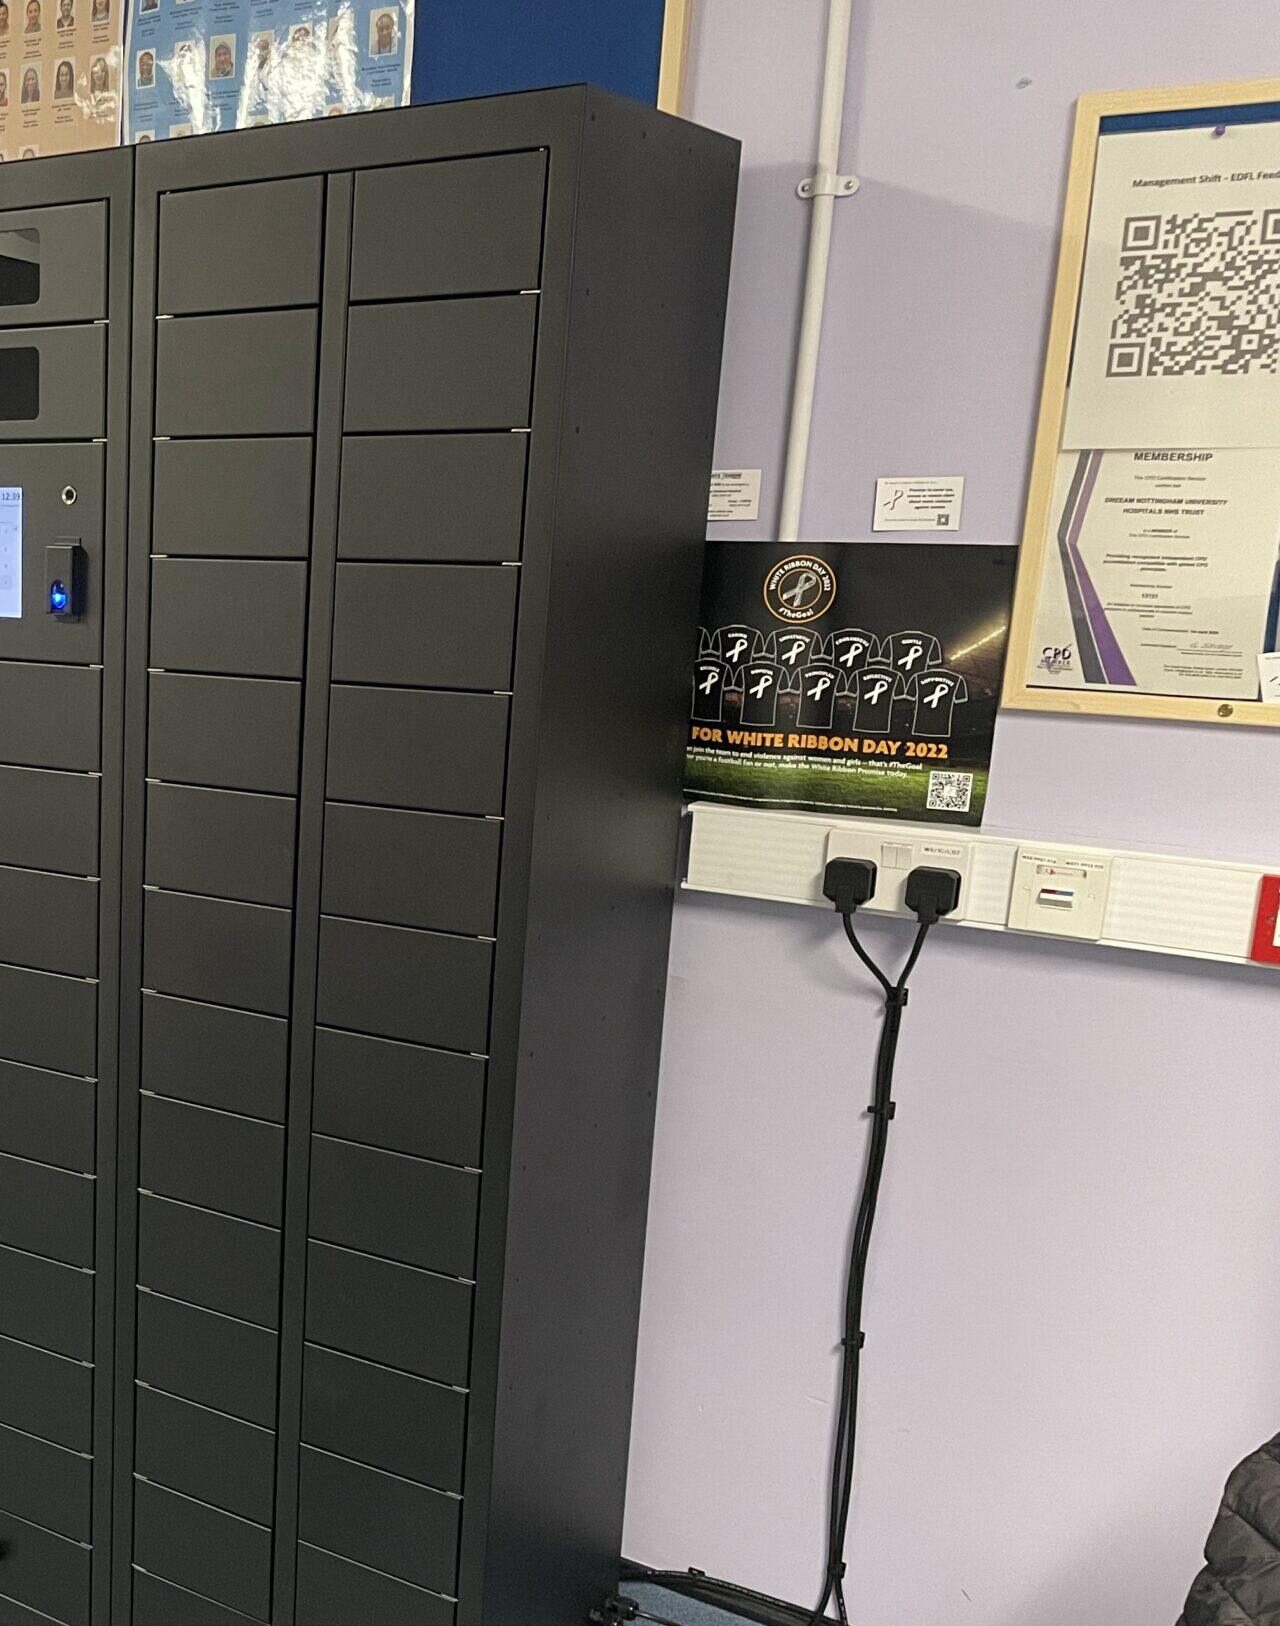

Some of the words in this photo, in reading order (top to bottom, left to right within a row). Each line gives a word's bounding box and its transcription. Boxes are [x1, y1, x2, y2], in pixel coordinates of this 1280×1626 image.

[1132, 175, 1196, 188] Management
[1198, 174, 1221, 184] Shift
[1230, 172, 1254, 182] EDFL
[1134, 452, 1213, 461] MEMBERSHIP
[769, 568, 785, 590] WHITE
[784, 561, 812, 571] RIBBON
[812, 564, 826, 576] DAY
[1043, 647, 1071, 660] CPD
[691, 726, 723, 743] FOR
[726, 730, 785, 748] WHITE
[787, 733, 859, 753] RIBBON
[862, 739, 902, 756] DAY
[904, 741, 949, 759] 2022
[754, 752, 782, 760] violence
[783, 754, 807, 762] against
[832, 757, 846, 765] and
[811, 763, 831, 772] White
[831, 765, 857, 773] Ribbon
[857, 767, 885, 776] Promise
